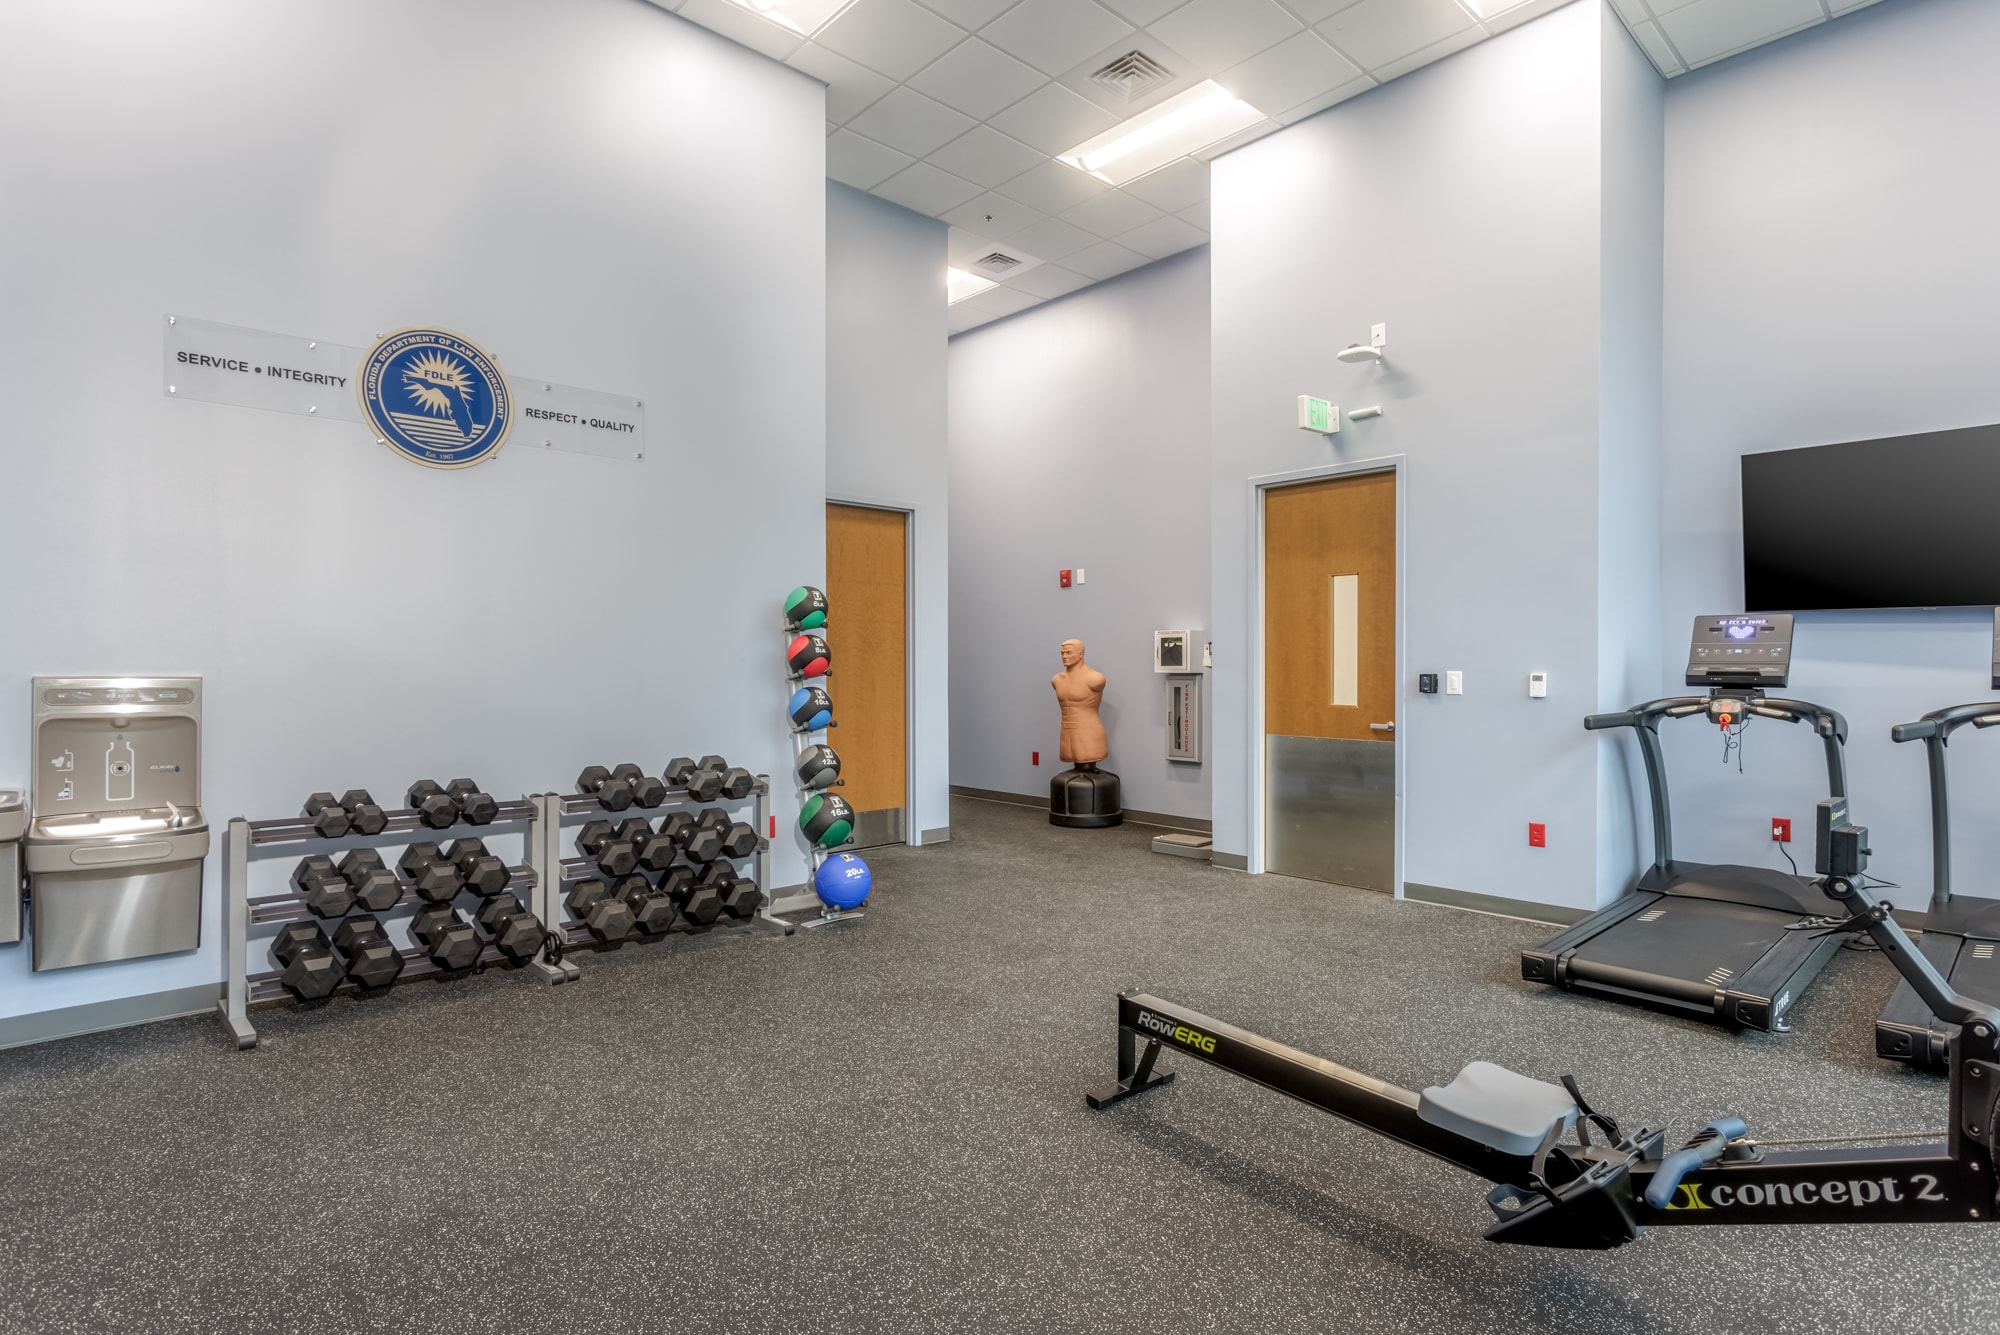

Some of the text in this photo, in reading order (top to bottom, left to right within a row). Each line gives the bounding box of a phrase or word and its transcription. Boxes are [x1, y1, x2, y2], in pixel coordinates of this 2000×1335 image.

[176, 351, 347, 388] SERVICE INTEGRITY
[368, 335, 505, 421] FLORIDA DEPARTMENT OF LAW ENFORCEMENT
[424, 369, 454, 382] FDLE
[525, 407, 635, 433] RESPECT QUALITY
[1710, 1177, 1904, 1207] concept
